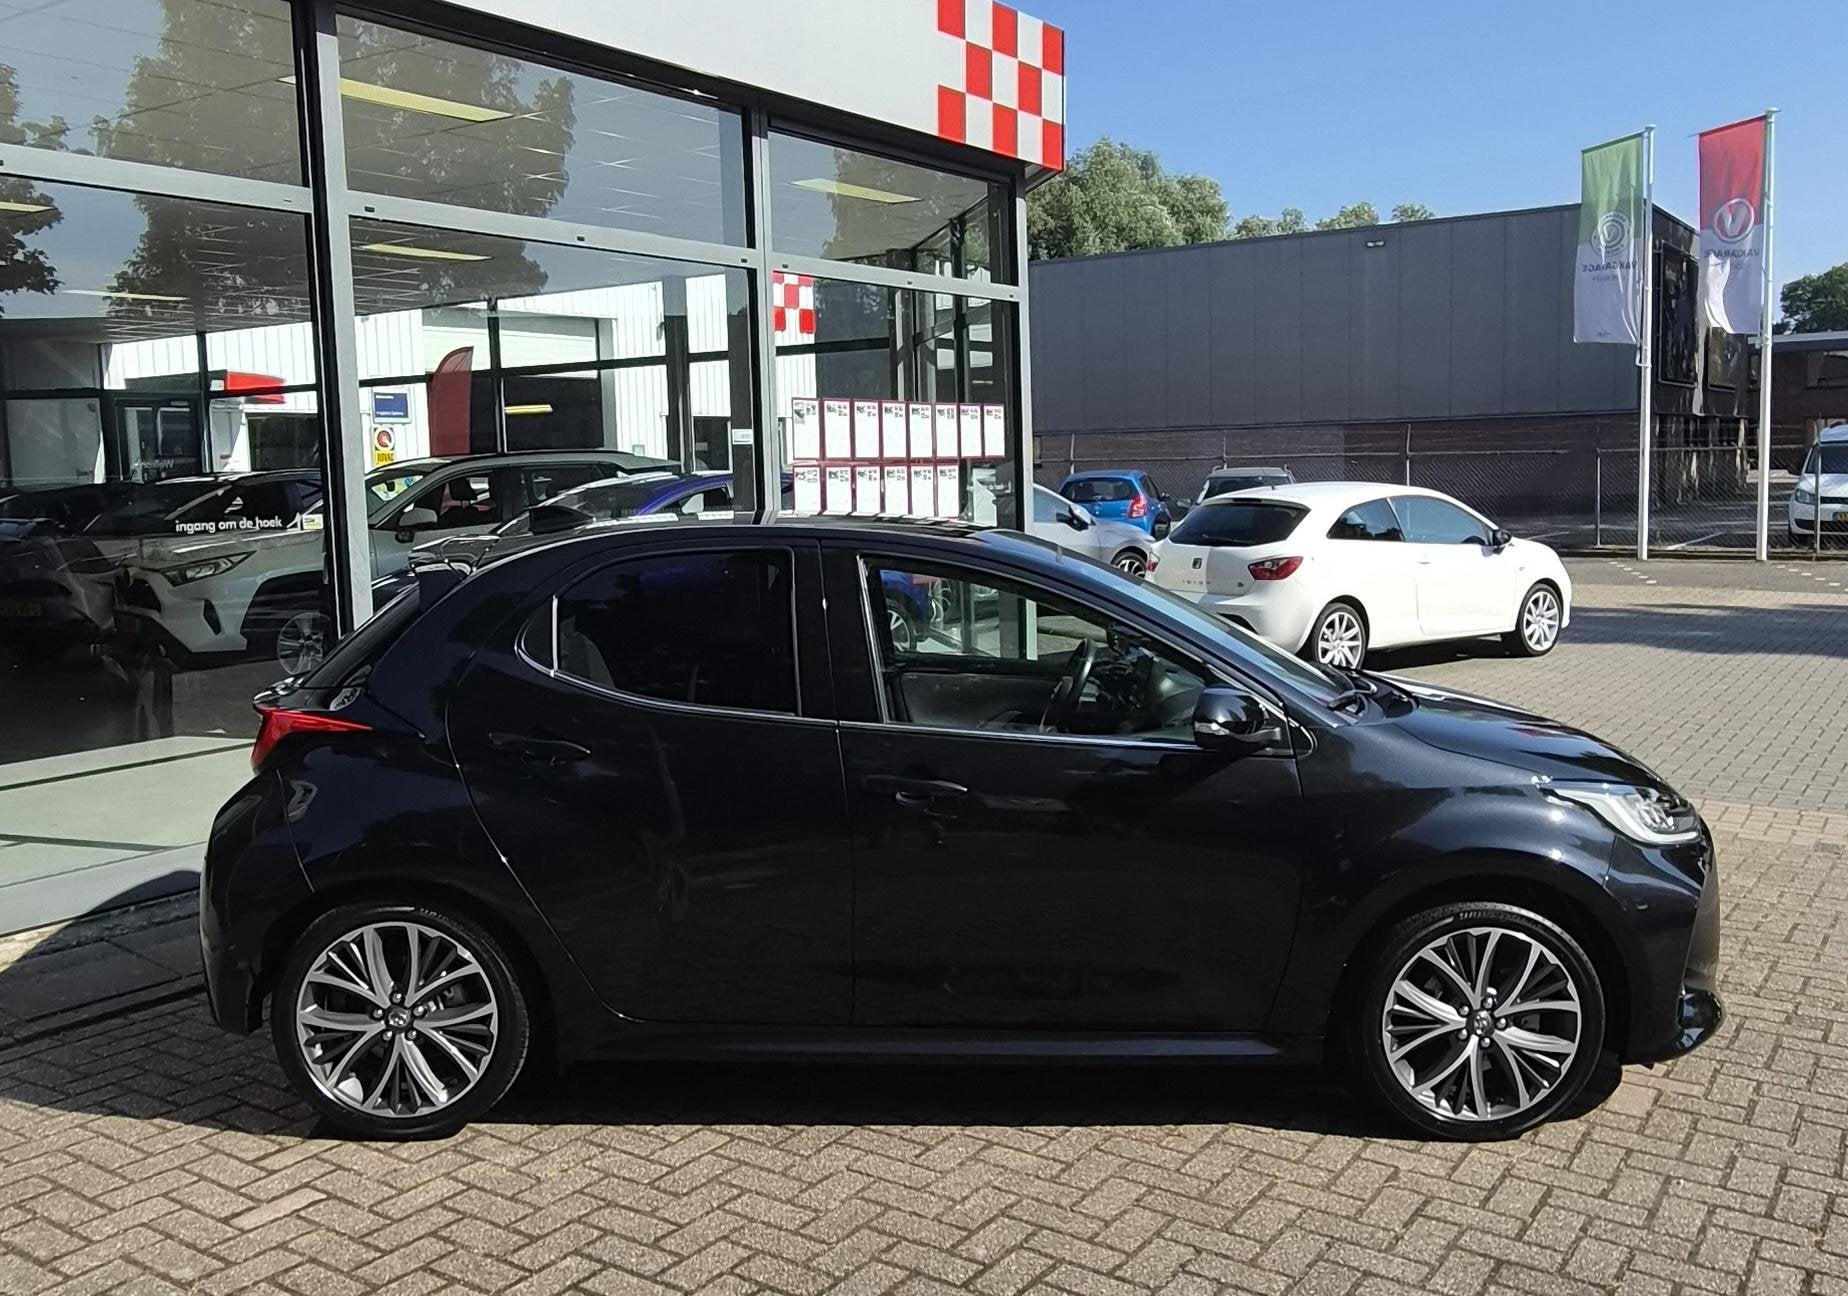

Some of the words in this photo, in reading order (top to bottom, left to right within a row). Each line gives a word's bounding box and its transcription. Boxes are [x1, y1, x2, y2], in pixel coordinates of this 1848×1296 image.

[175, 519, 216, 535] ingang
[218, 519, 237, 530] om
[238, 516, 254, 530] de
[255, 515, 283, 530] hoek
